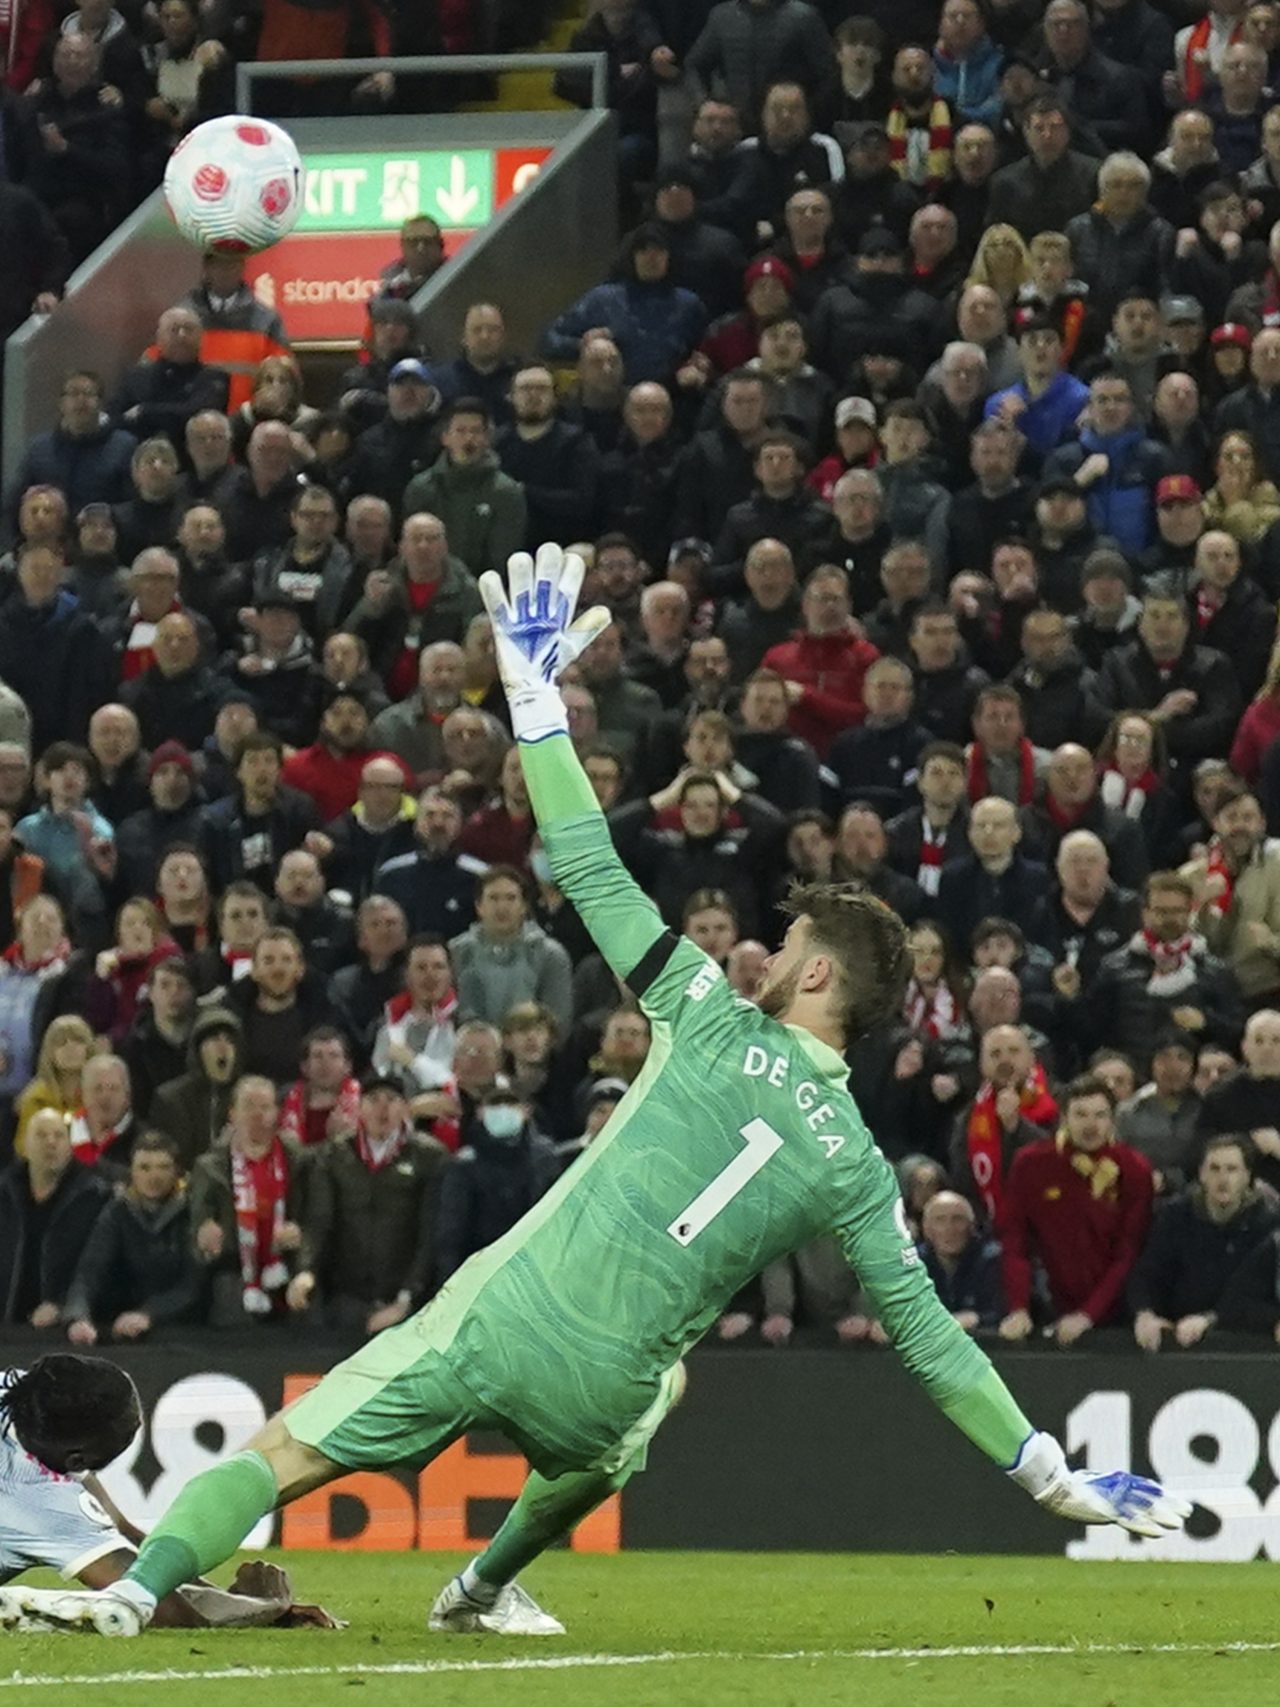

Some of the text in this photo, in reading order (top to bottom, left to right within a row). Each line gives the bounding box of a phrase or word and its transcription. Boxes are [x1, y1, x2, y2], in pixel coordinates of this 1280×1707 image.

[282, 275, 380, 304] standa
[743, 1045, 846, 1159] DE GEA
[666, 1116, 785, 1247] 1
[1066, 1387, 1280, 1562] 18
